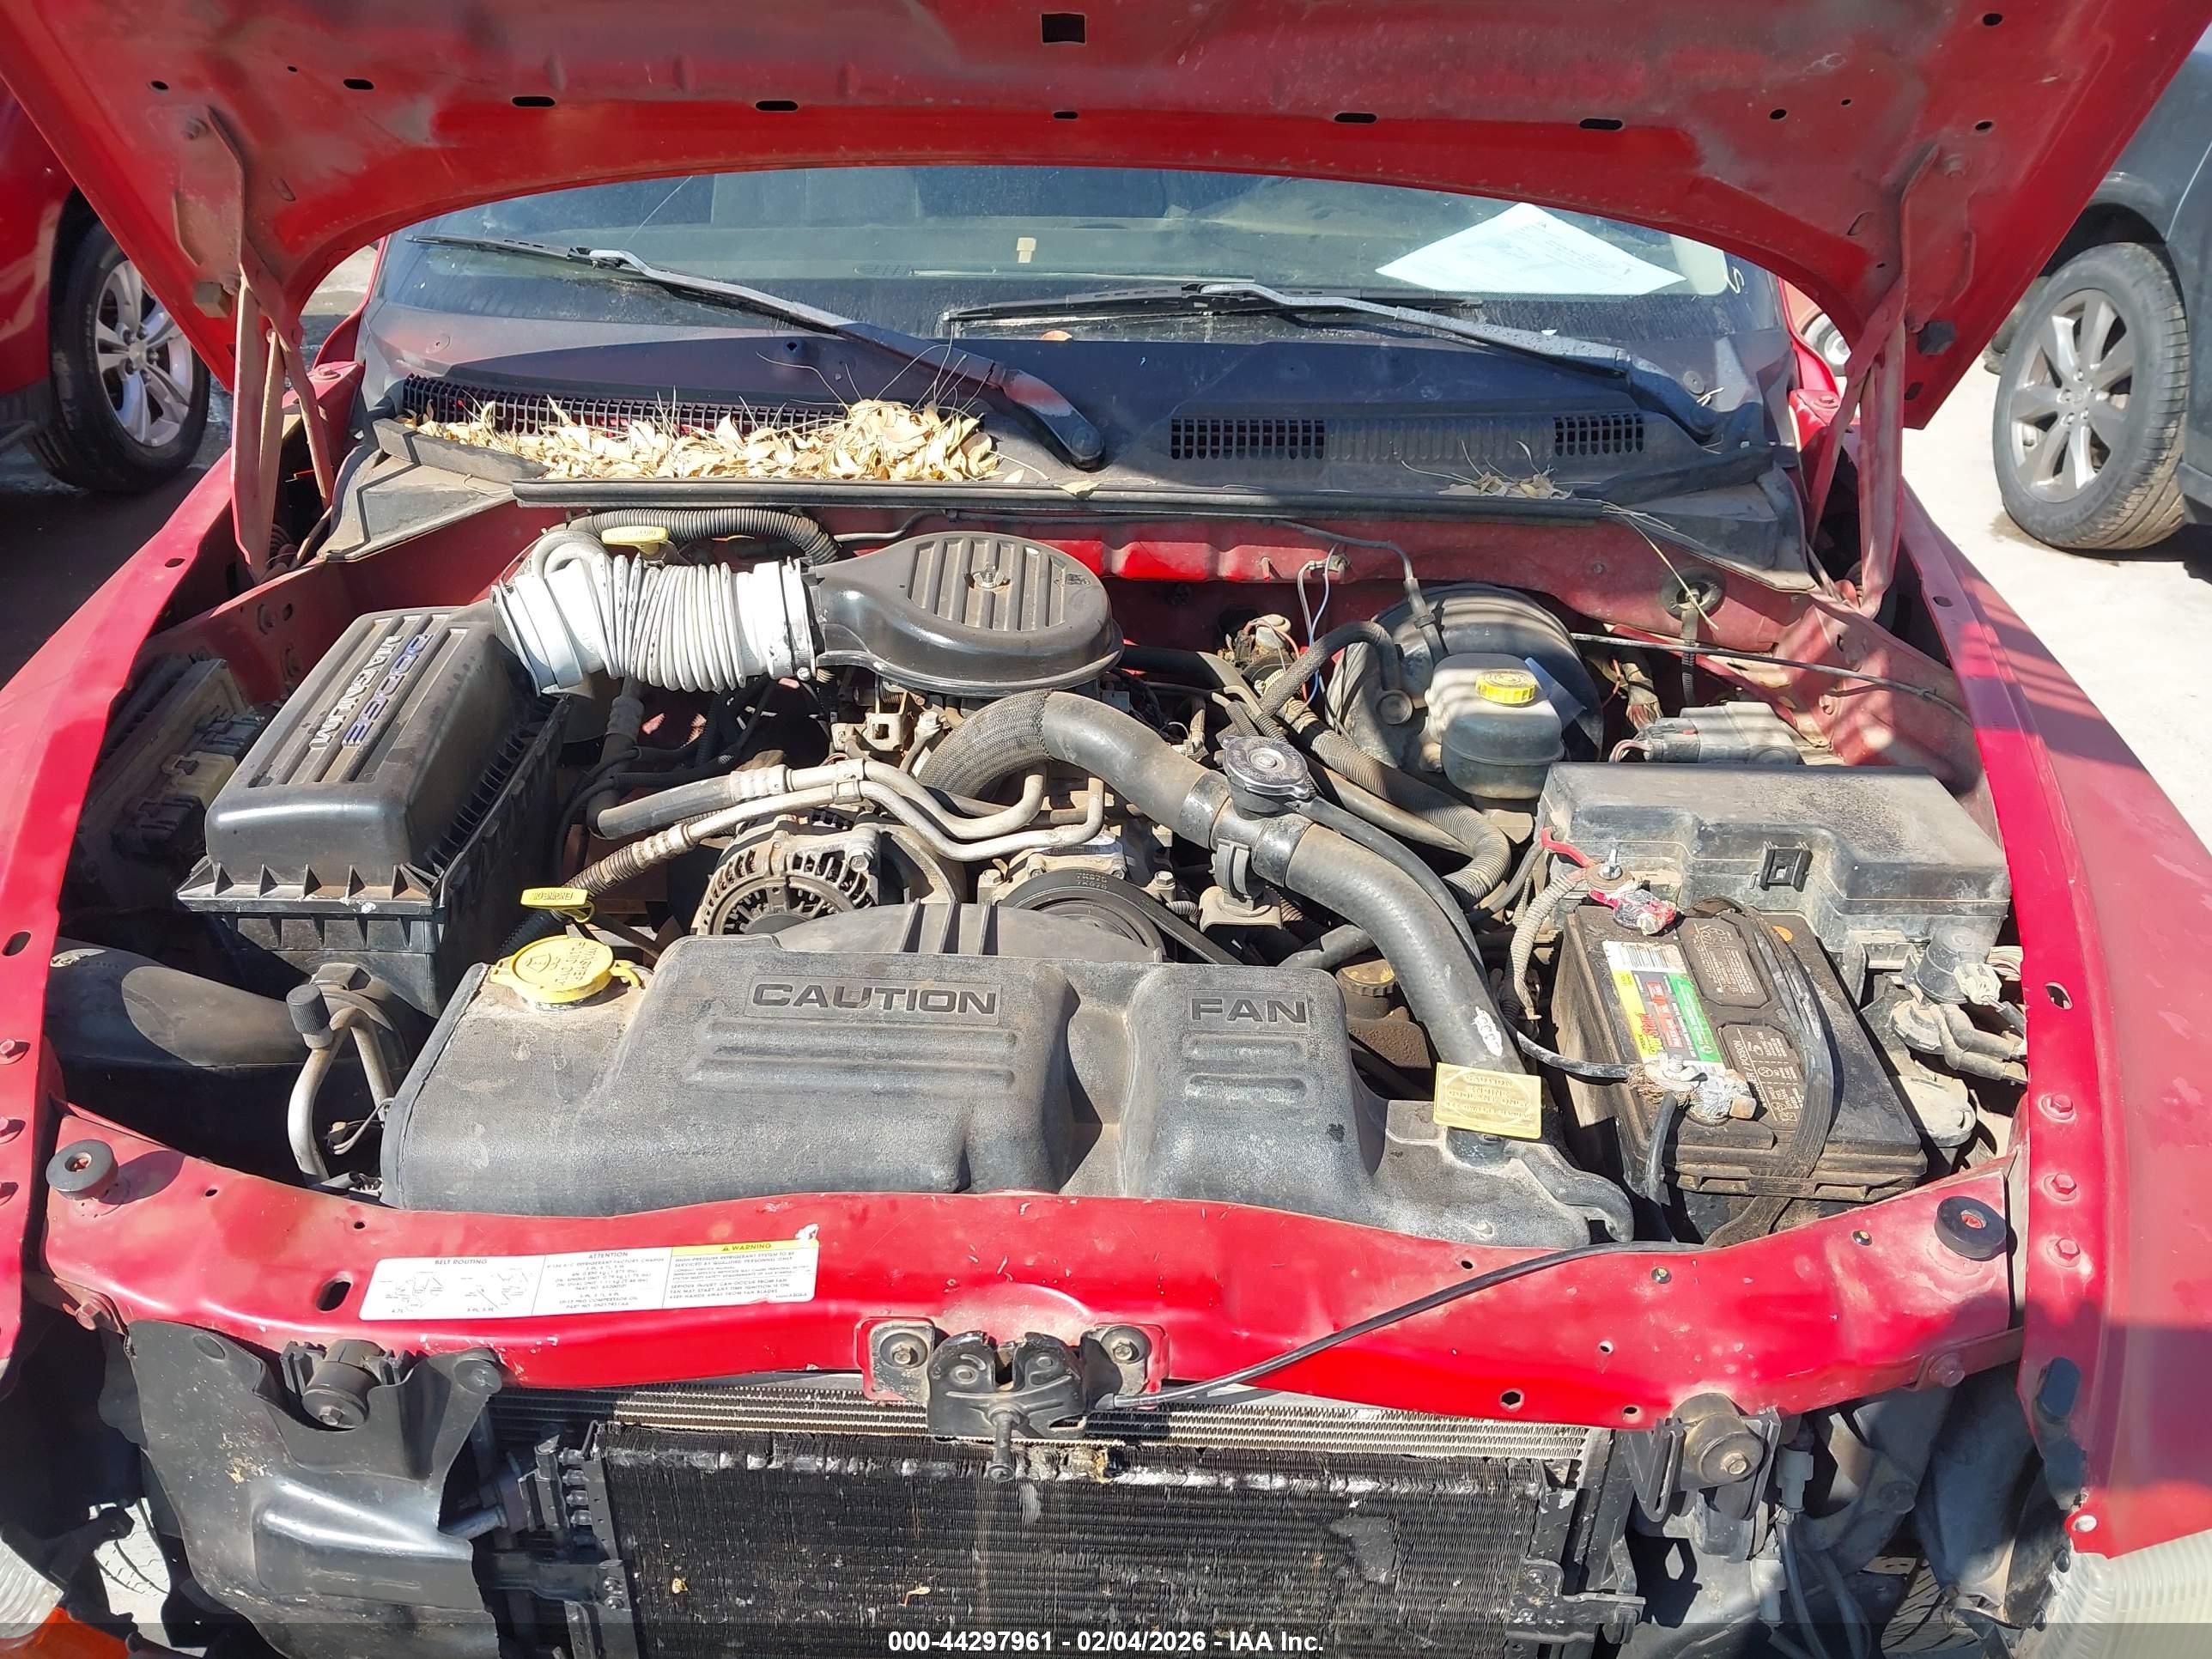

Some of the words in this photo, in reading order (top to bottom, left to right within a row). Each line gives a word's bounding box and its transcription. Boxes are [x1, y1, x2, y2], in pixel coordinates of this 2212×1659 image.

[309, 635, 404, 749] MAGNUM
[342, 634, 434, 747] DODGE
[543, 891, 574, 901] ENGINE
[752, 983, 997, 1015] CAUTION
[1190, 996, 1307, 1023] FAN
[1733, 1040, 1750, 1066] POISON
